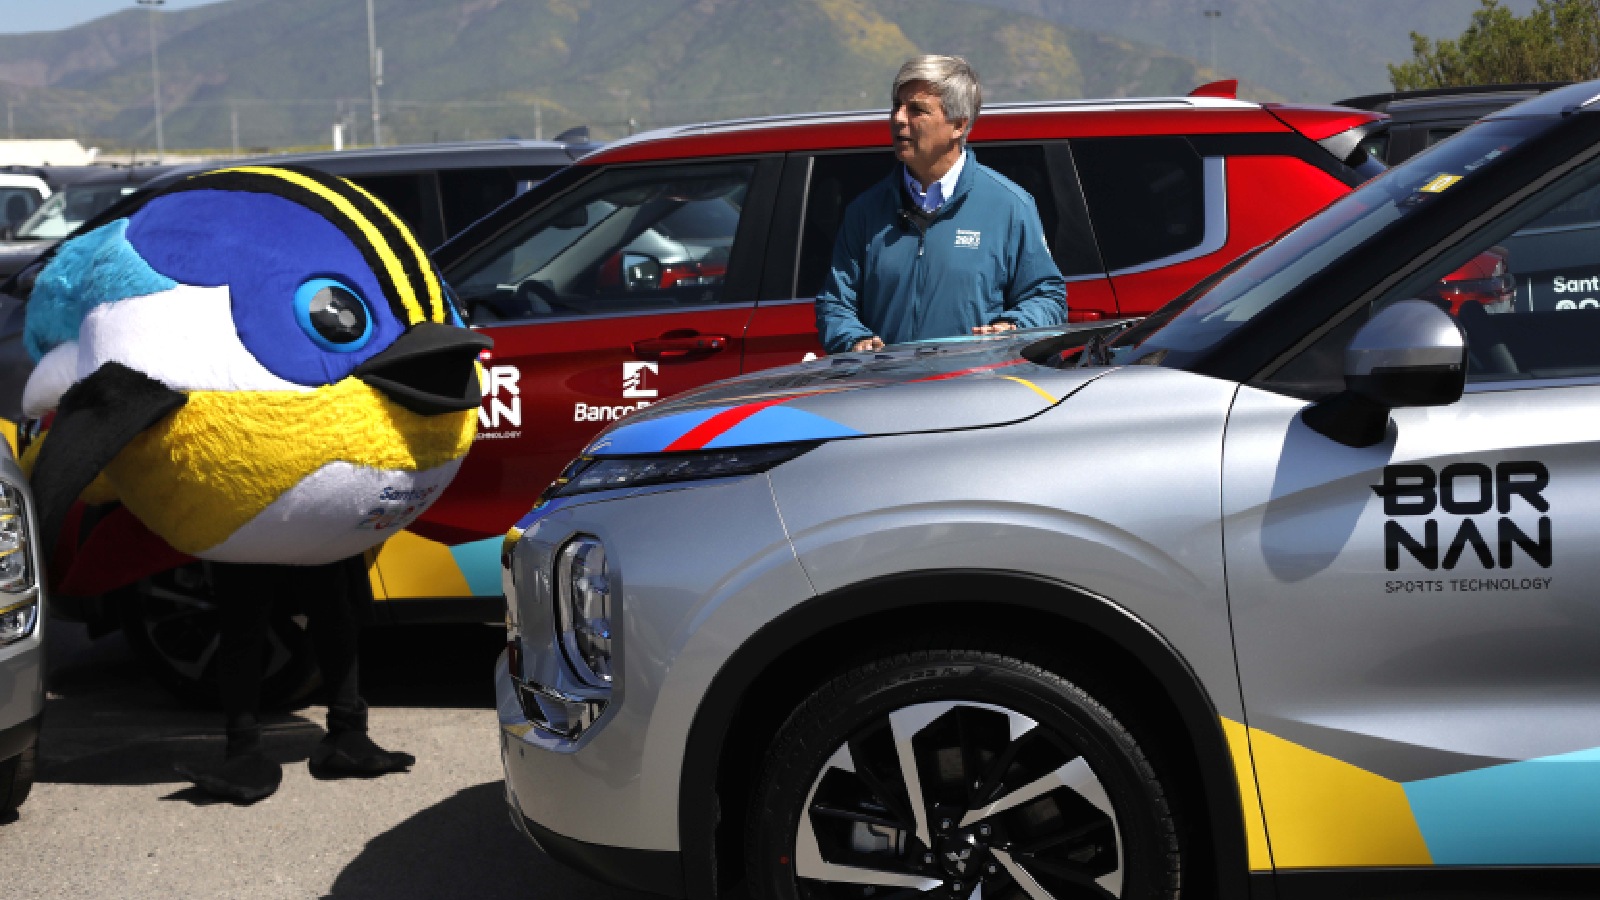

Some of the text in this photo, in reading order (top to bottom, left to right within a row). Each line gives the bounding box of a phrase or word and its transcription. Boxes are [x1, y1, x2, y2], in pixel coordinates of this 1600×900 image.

[1370, 461, 1550, 516] BOR
[1384, 515, 1553, 571] NAN
[1385, 577, 1553, 593] SPORTS TECHNOLOGY
